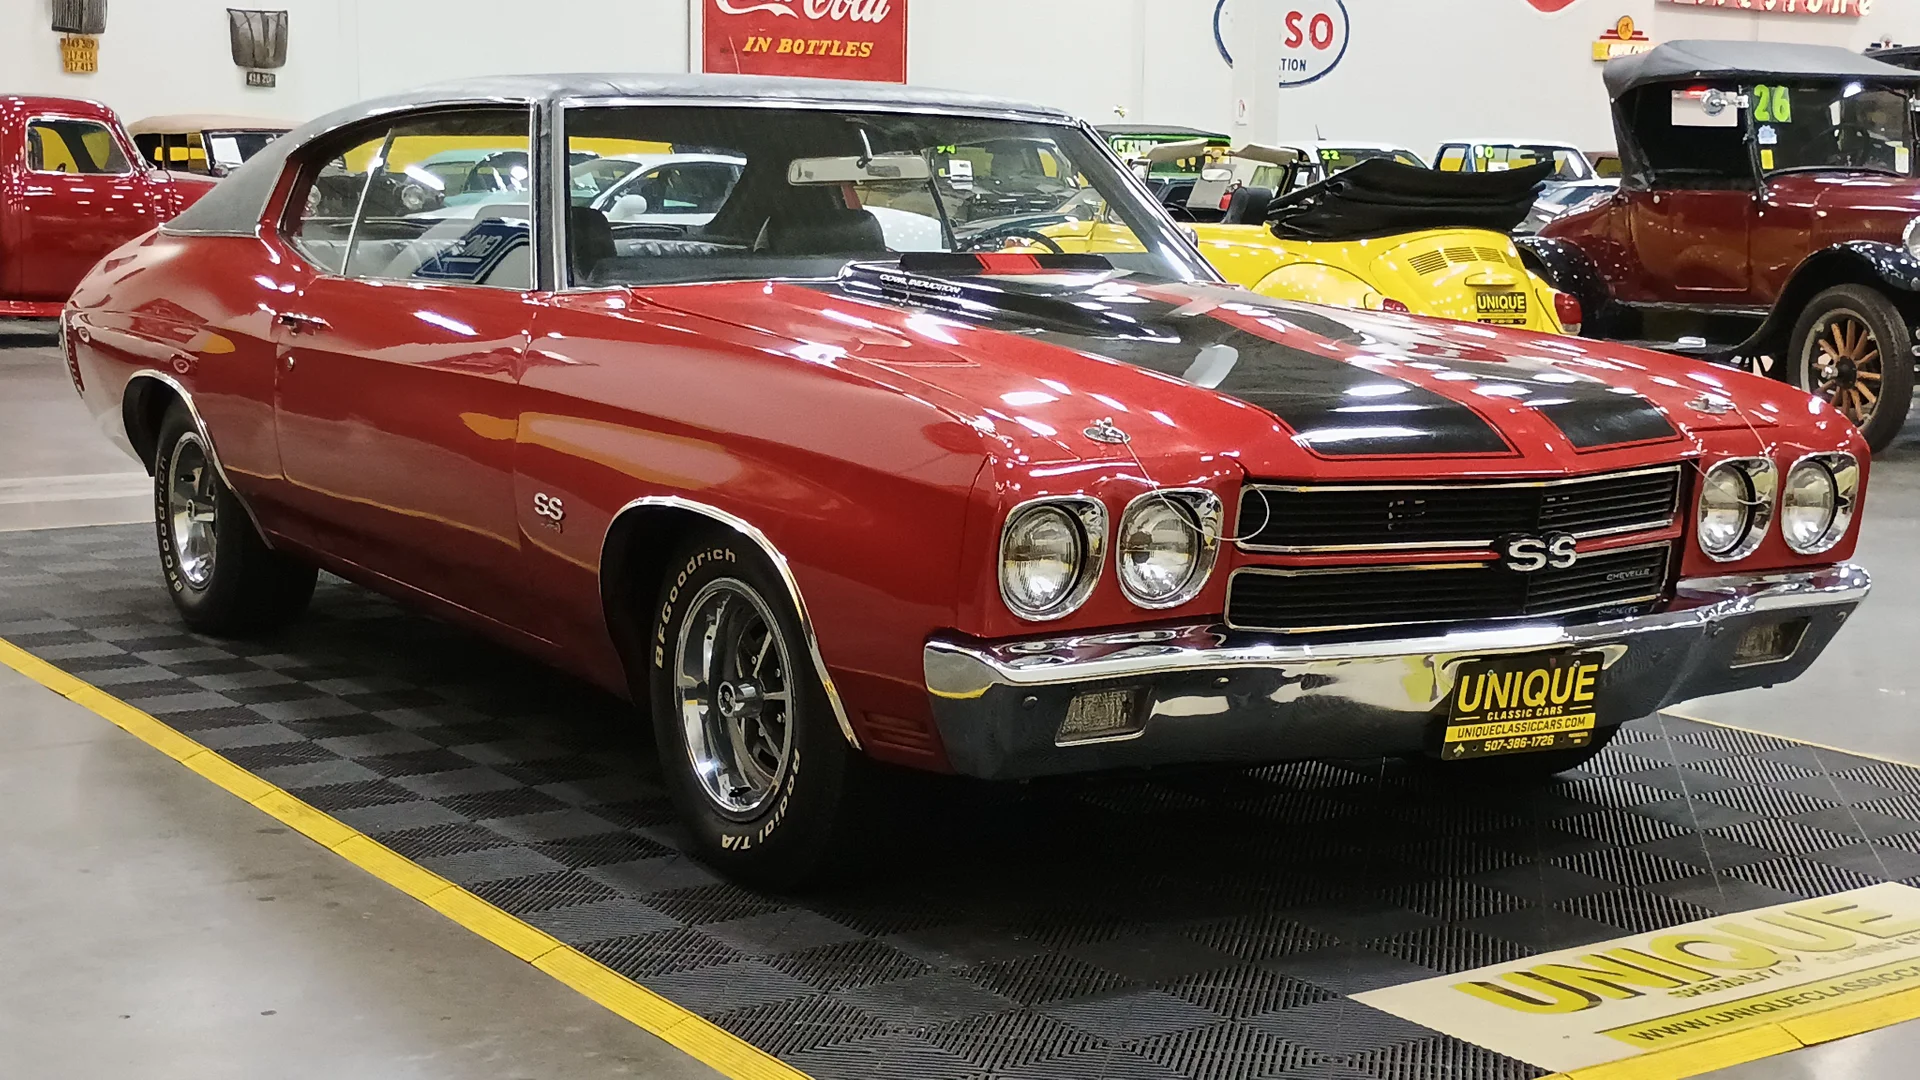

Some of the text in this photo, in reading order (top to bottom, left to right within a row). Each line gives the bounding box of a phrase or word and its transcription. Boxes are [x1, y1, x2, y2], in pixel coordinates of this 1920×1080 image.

[1284, 11, 1334, 50] SO
[742, 36, 874, 57] IN BOTTLES
[1279, 58, 1307, 71] TION
[1753, 84, 1791, 122] 26
[1320, 150, 1340, 160] 22
[908, 279, 962, 294] INDUCTION
[1477, 294, 1526, 310] UNIQUE
[533, 492, 564, 521] SS
[1506, 535, 1577, 572] SS
[1606, 568, 1650, 581] CHEVELLE
[655, 547, 736, 669] BFGoodrich
[1457, 663, 1599, 713] UNIQUE
[1486, 705, 1563, 721] CLASSIC CARS
[1457, 716, 1586, 739] UNIQUECLASSICCARS.COM
[1484, 735, 1555, 752] 507-386-1726
[721, 747, 800, 851] Radial T/A
[1449, 898, 1920, 1014] UNIQUE
